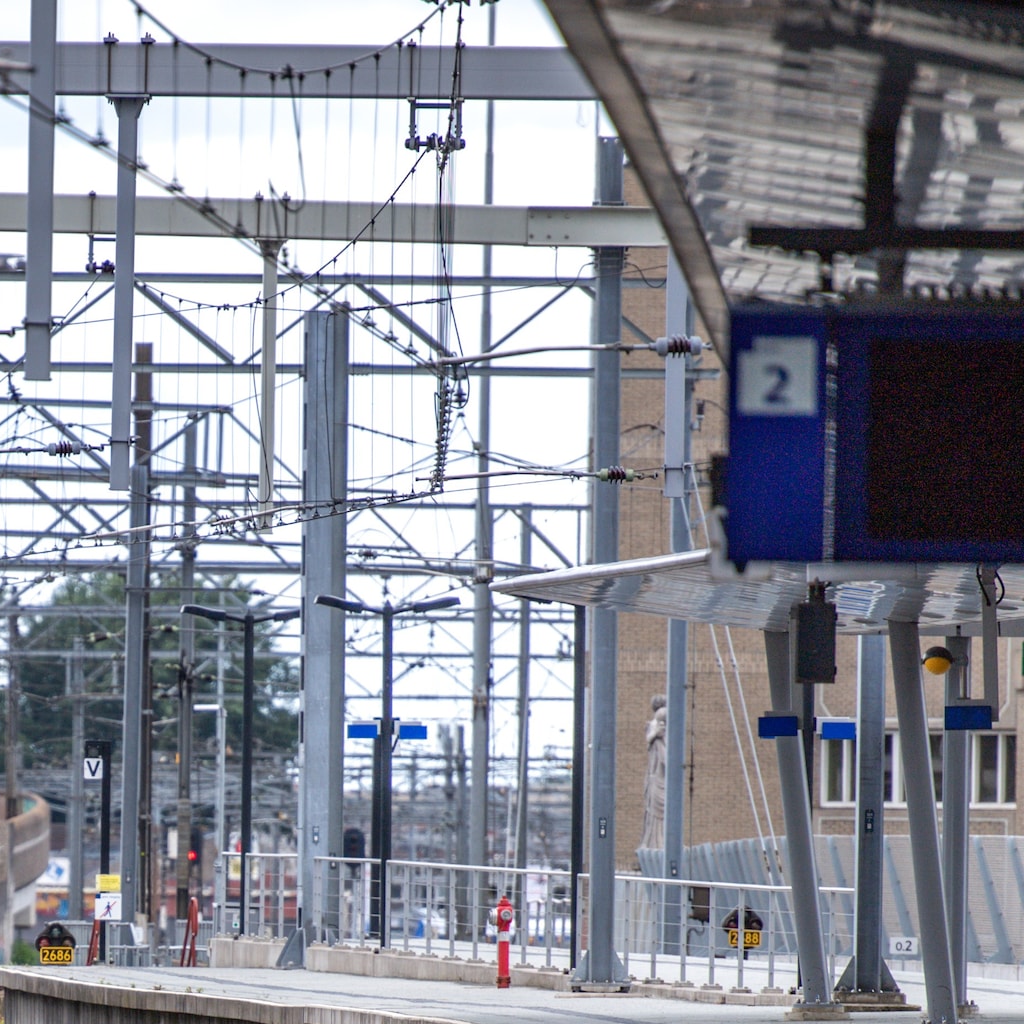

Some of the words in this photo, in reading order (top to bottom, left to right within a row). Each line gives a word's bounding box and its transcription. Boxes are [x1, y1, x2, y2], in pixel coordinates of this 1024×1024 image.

[763, 364, 790, 403] 2
[86, 760, 100, 777] V
[732, 932, 759, 944] 288
[895, 940, 912, 951] 0.2
[43, 949, 71, 961] 2686
